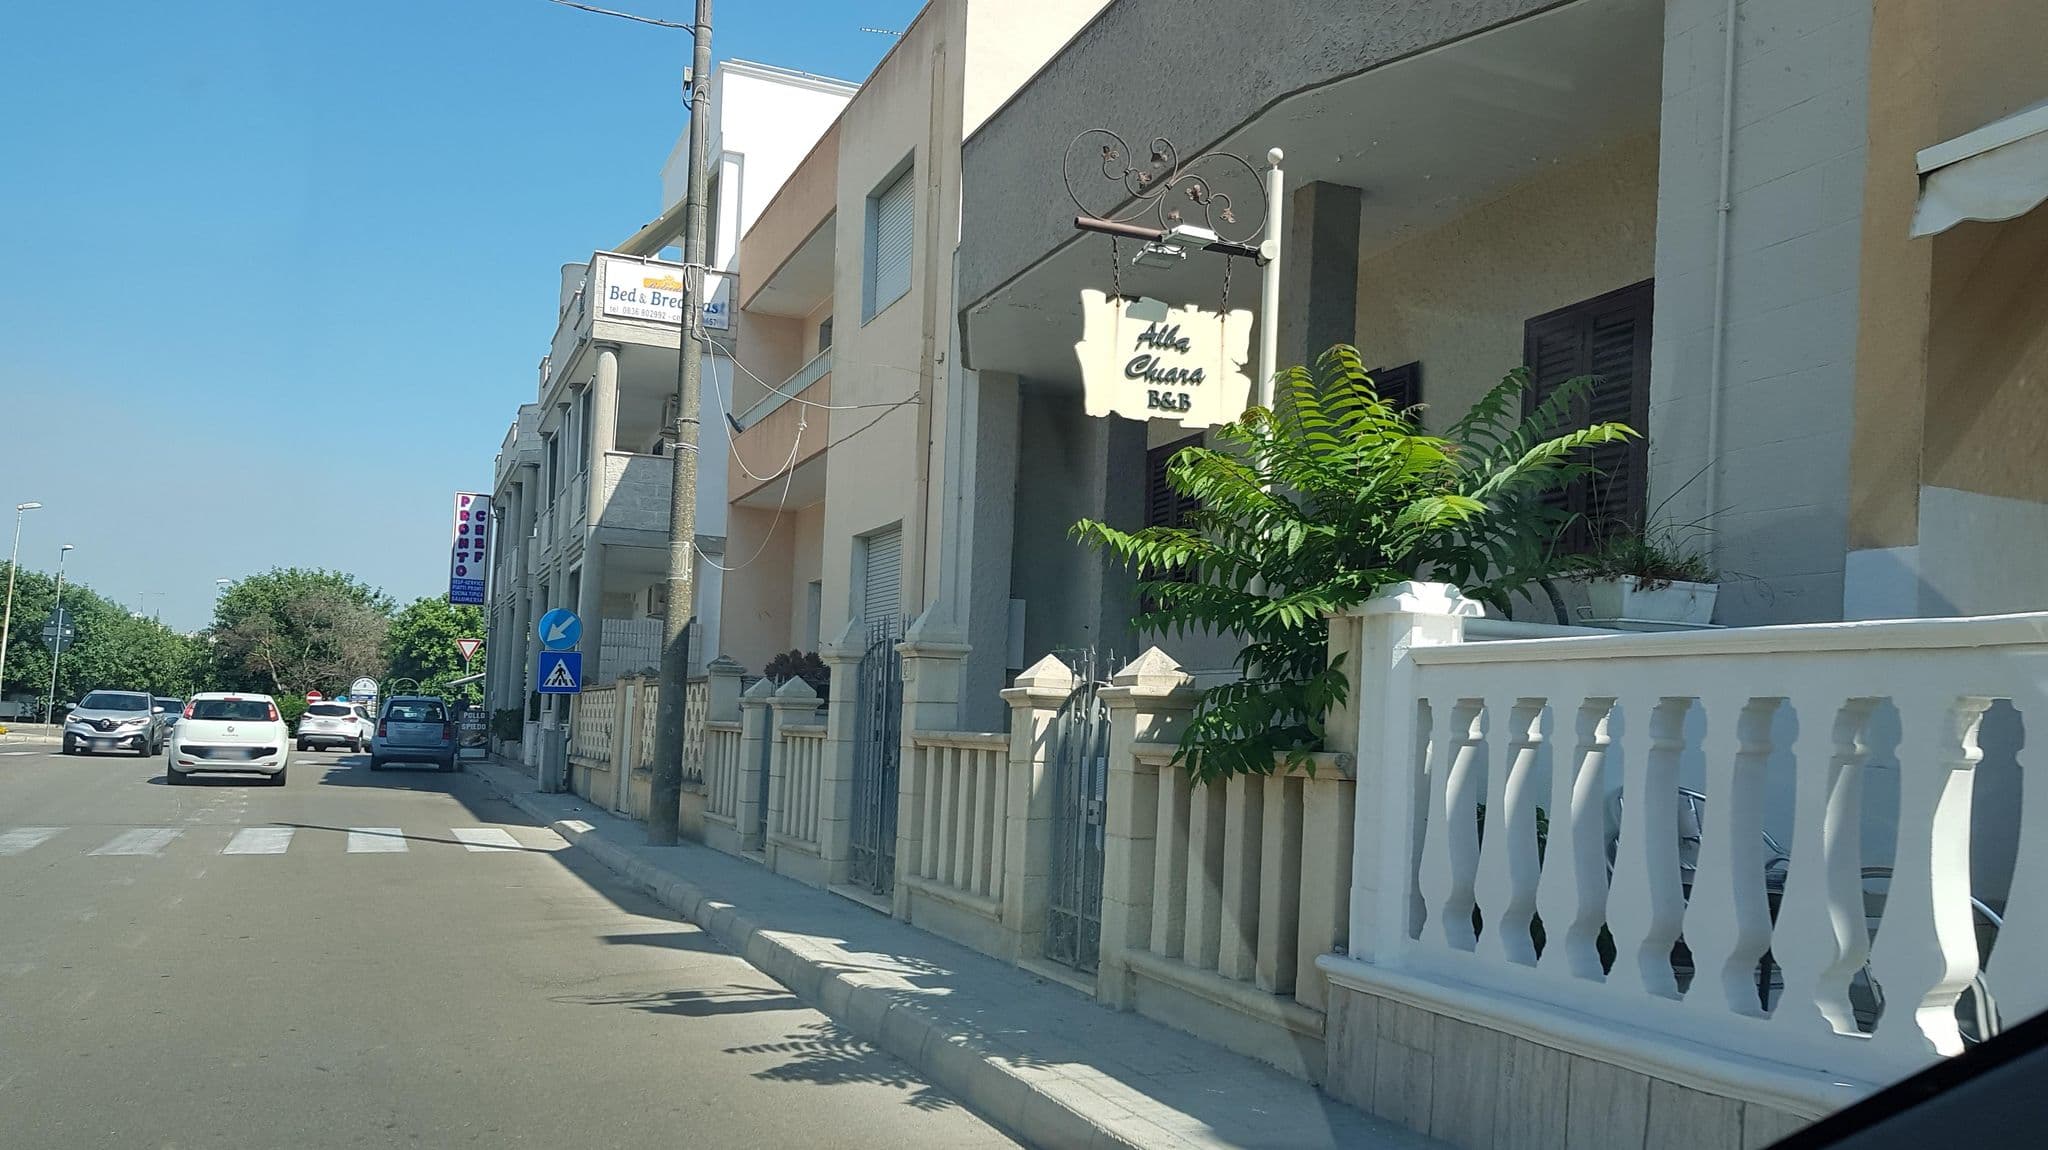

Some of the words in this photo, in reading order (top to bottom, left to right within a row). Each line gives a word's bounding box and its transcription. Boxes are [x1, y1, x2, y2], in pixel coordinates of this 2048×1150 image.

[609, 285, 637, 302] Bed
[639, 293, 647, 304] &
[1134, 321, 1191, 355] Alba
[1147, 389, 1192, 413] B&B
[455, 495, 470, 577] PRONTO
